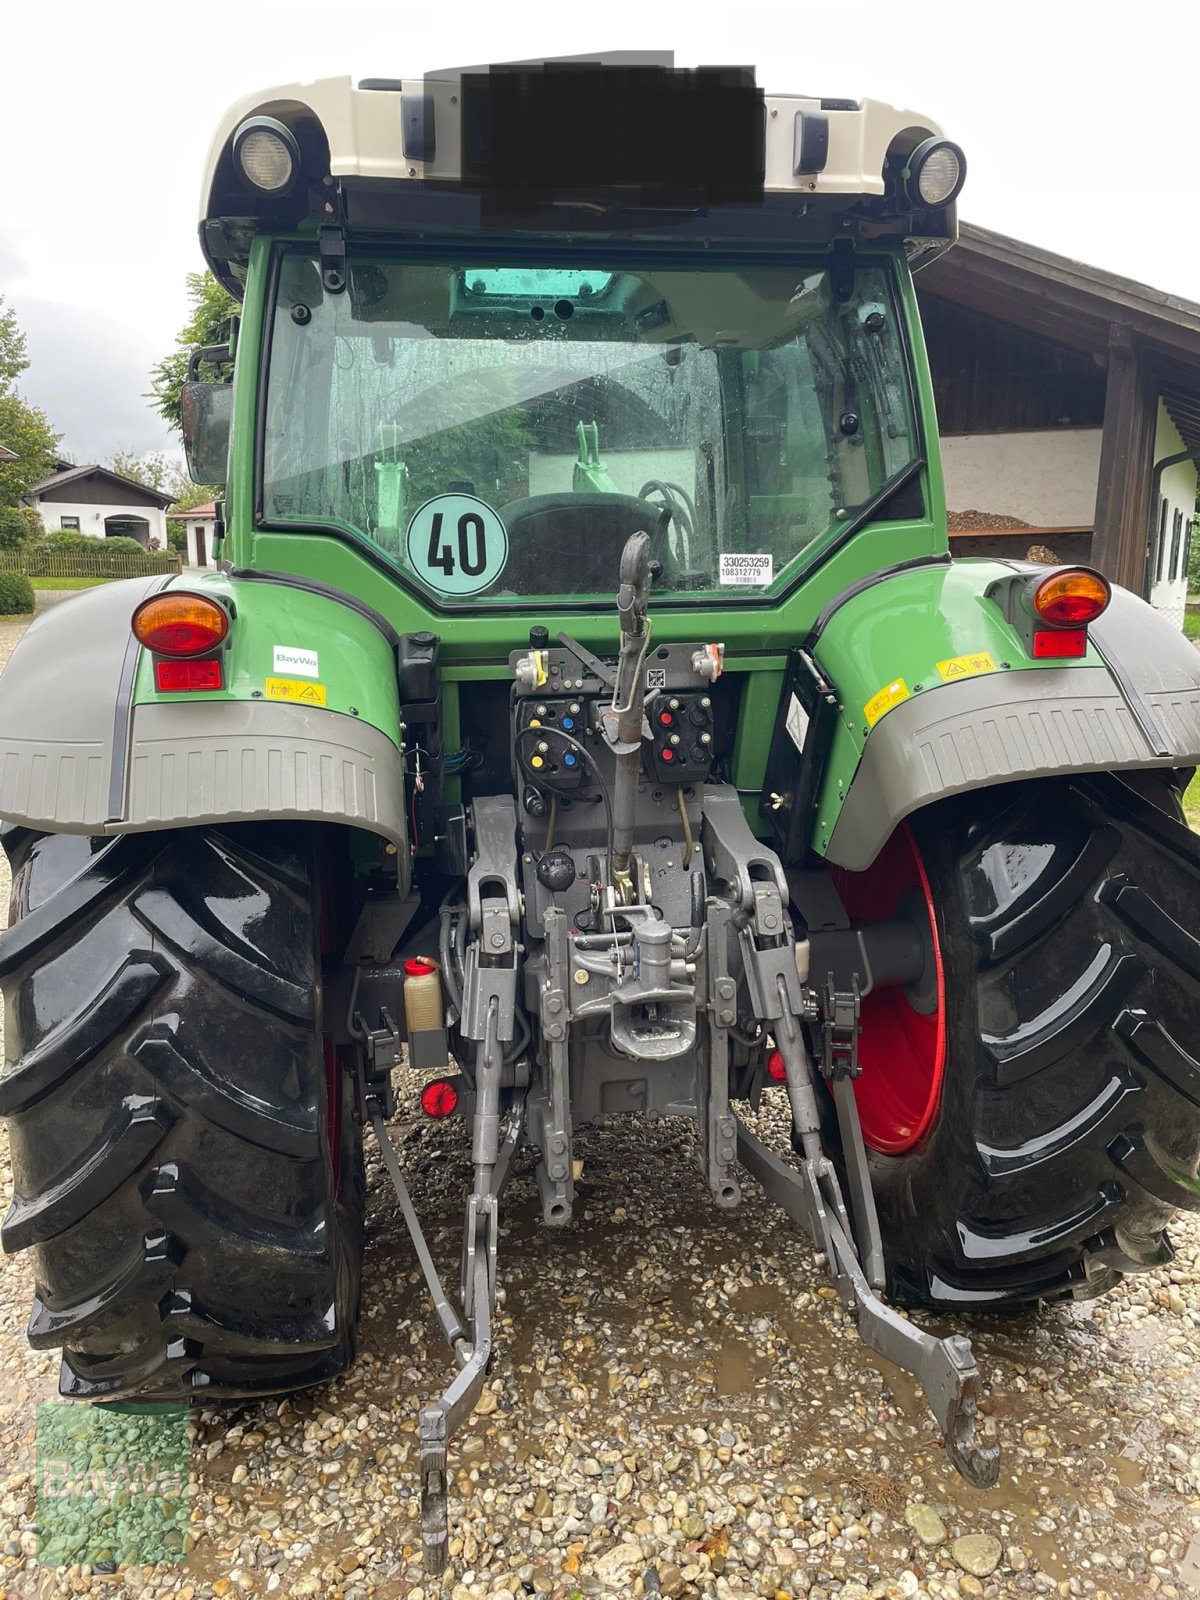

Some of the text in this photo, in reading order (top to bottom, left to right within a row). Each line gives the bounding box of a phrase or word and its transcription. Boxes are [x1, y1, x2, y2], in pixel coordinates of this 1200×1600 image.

[428, 512, 487, 577] 40
[723, 557, 769, 567] 330253259
[721, 568, 761, 576] 108312779
[276, 653, 317, 667] BayWa
